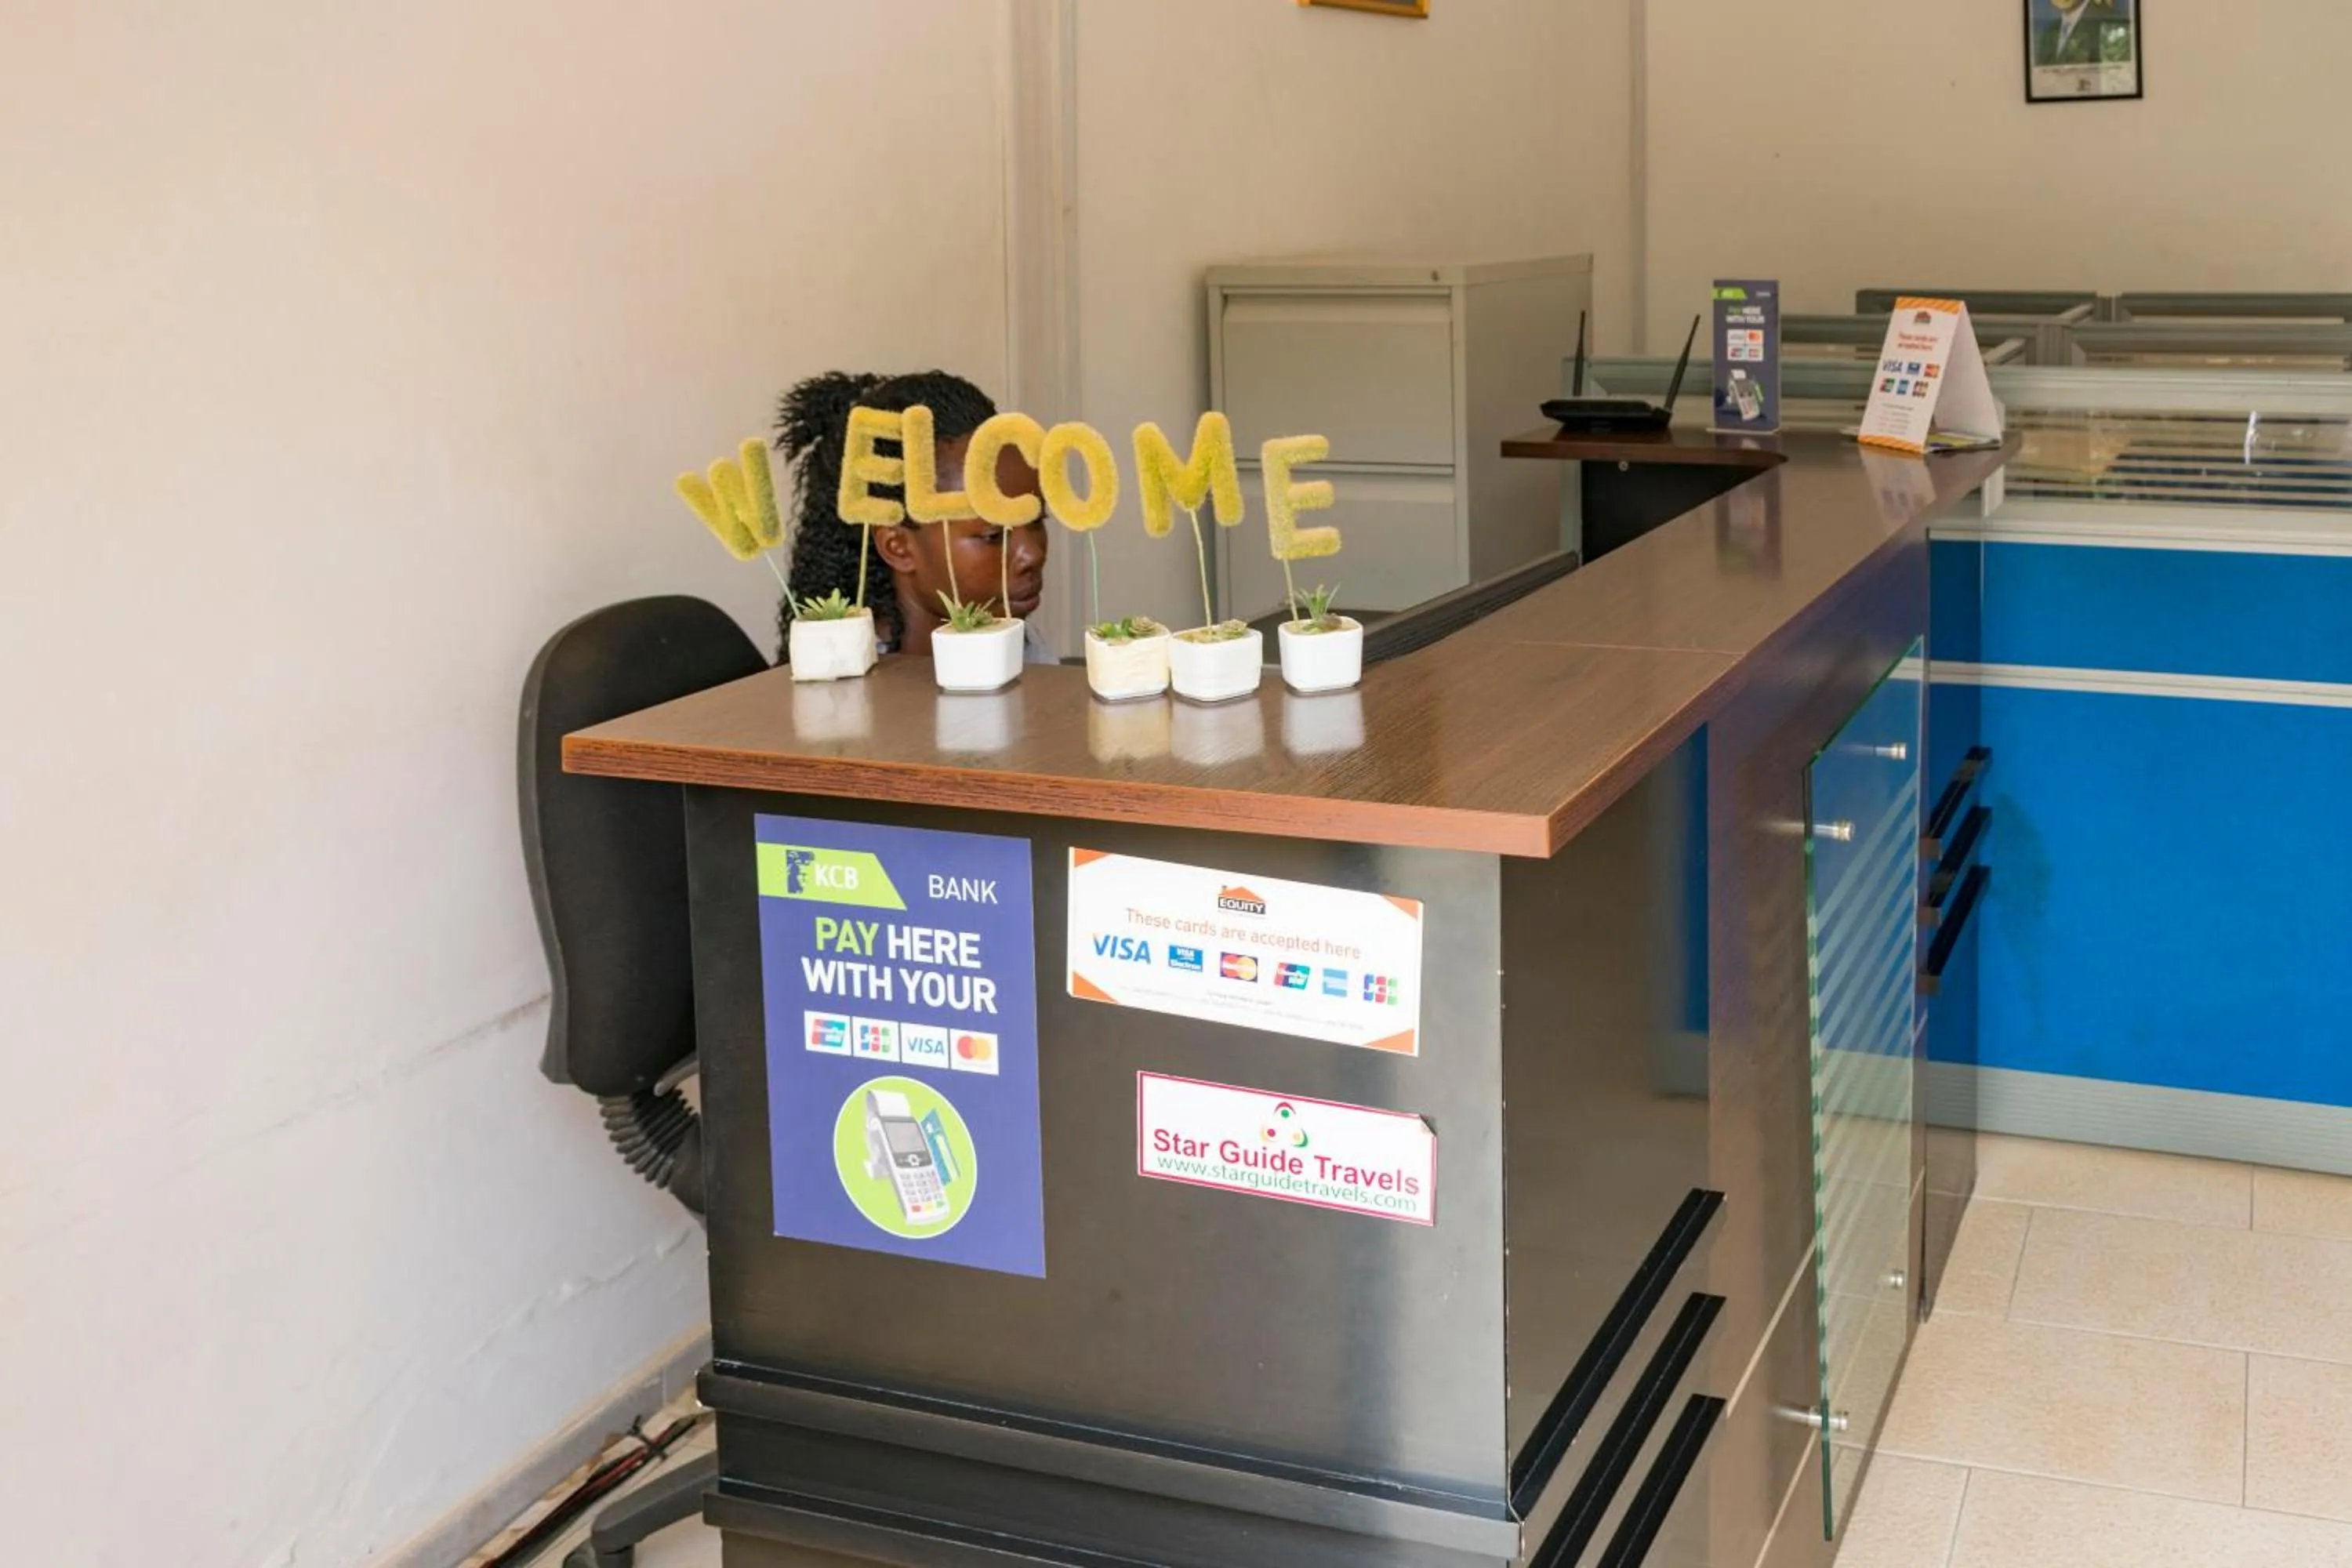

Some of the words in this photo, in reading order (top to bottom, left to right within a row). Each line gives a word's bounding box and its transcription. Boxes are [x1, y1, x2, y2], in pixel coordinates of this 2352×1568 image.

[676, 404, 1342, 561] WELCOME
[814, 864, 858, 891] KCB
[928, 874, 999, 905] BANK
[1219, 898, 1265, 915] EQUITY
[815, 916, 880, 956] PAY
[887, 924, 982, 969] HERE
[1093, 934, 1152, 965] VISA
[1126, 907, 1171, 929] These
[1175, 917, 1217, 938] cards
[1221, 927, 1247, 941] are
[1250, 929, 1320, 953] accepted
[1325, 942, 1362, 960] here
[800, 956, 893, 1002] WITH
[898, 967, 998, 1014] YOUR
[907, 1036, 946, 1054] VISA
[1153, 1128, 1210, 1159] Star
[1219, 1140, 1304, 1174] Guide
[1314, 1154, 1420, 1196] Travels
[1156, 1154, 1417, 1213] www.starguidetravels.com
